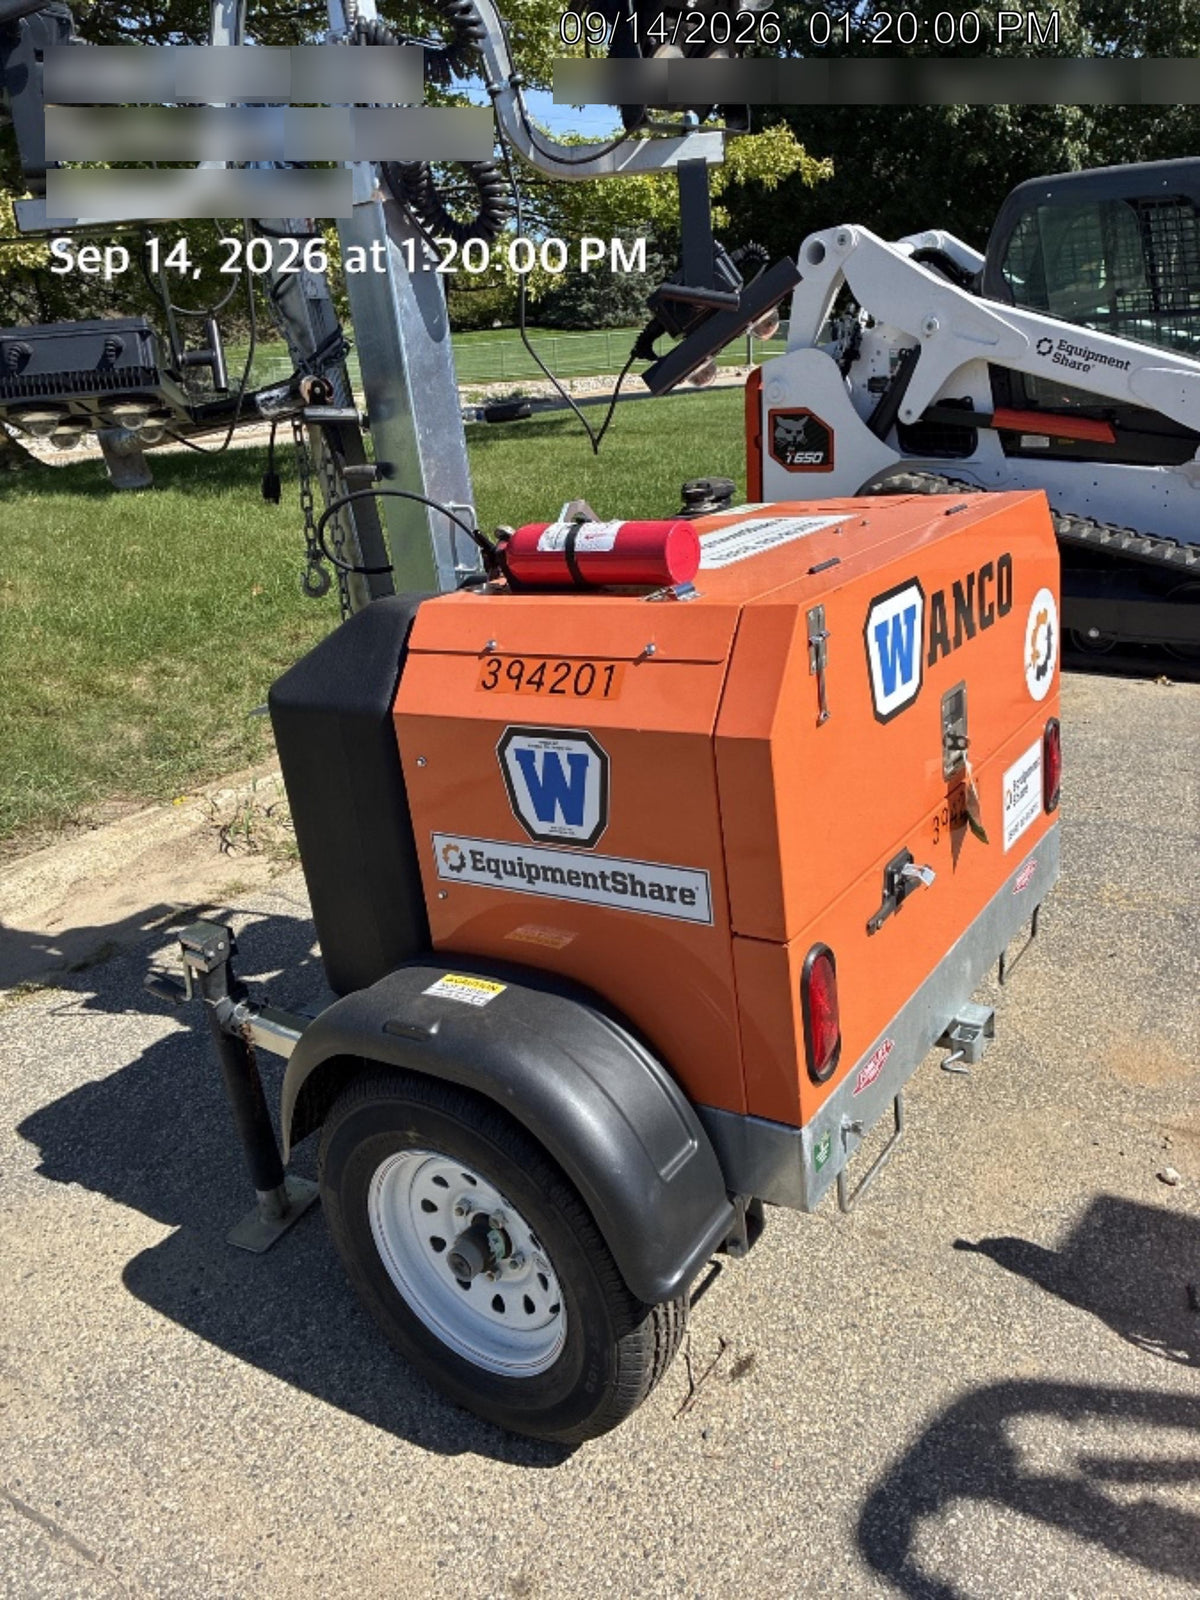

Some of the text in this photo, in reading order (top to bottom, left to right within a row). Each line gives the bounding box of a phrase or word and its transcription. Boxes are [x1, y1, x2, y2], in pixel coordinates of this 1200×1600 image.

[1051, 351, 1092, 373] Share
[1056, 338, 1132, 371] Equipment
[480, 657, 616, 698] 394201
[512, 747, 590, 828] W
[468, 848, 697, 907] EquipmentShare
